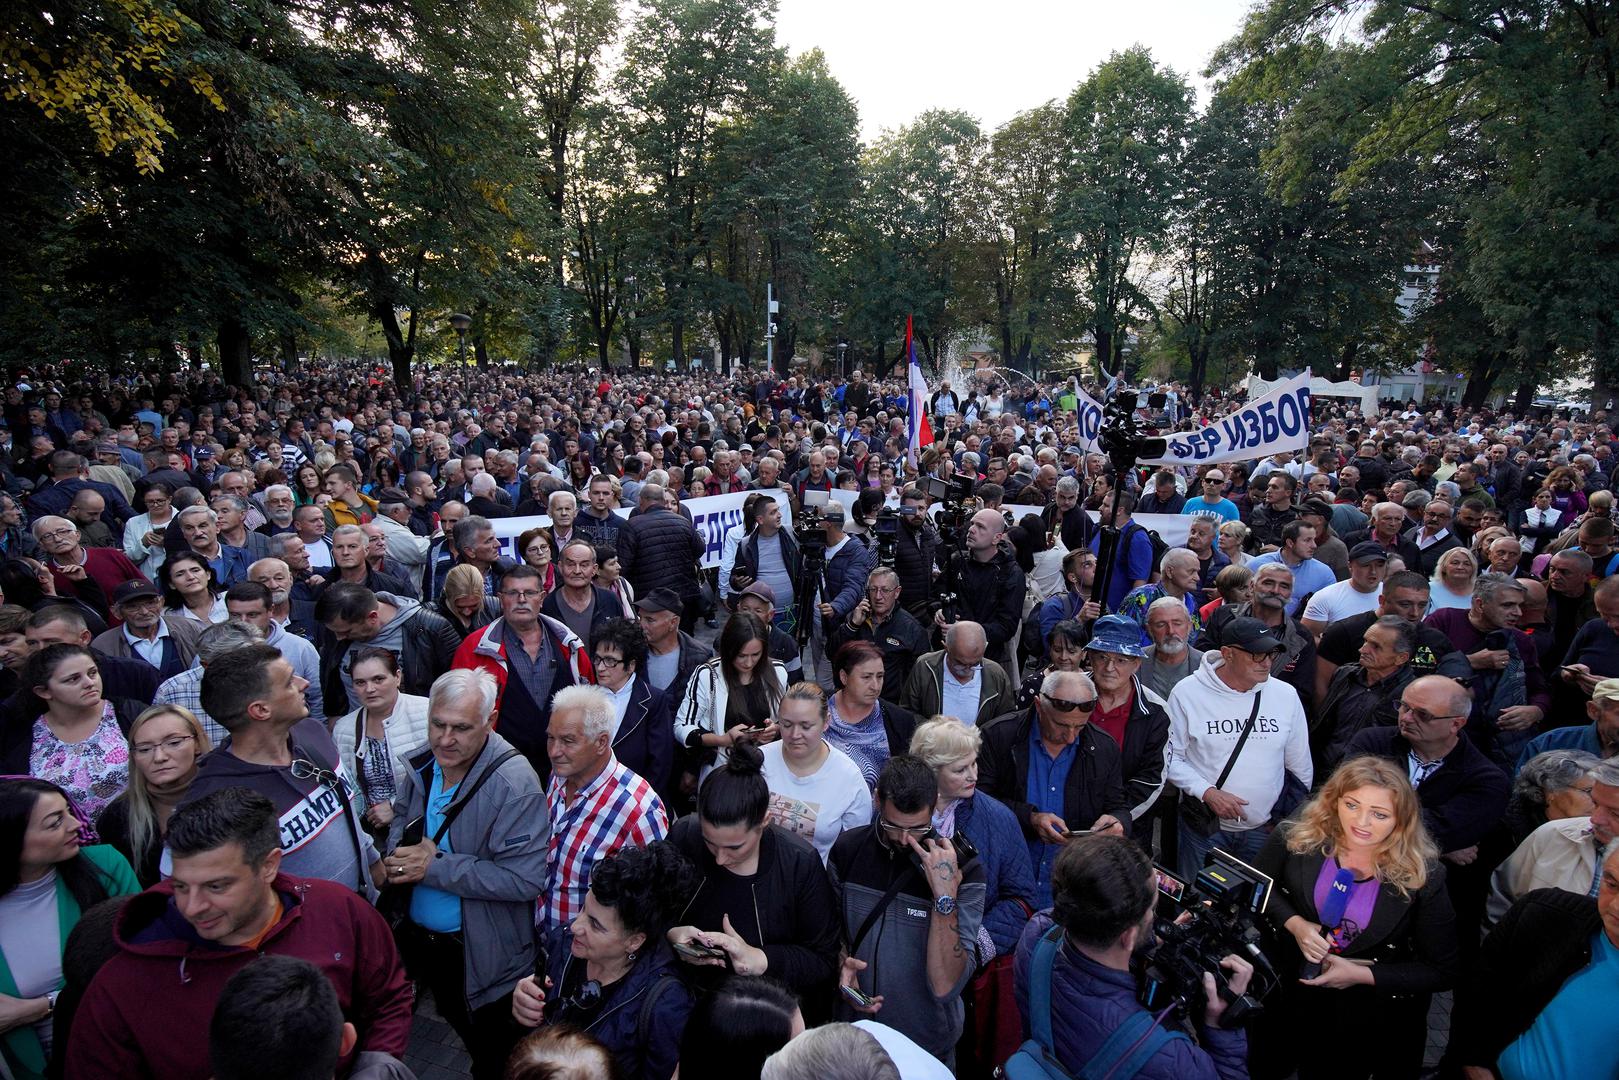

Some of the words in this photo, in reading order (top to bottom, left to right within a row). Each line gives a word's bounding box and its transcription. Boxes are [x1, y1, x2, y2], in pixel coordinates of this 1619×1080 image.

[1168, 427, 1222, 459] ФЕР
[280, 772, 353, 850] CHAMPIN
[1333, 880, 1347, 893] N1
